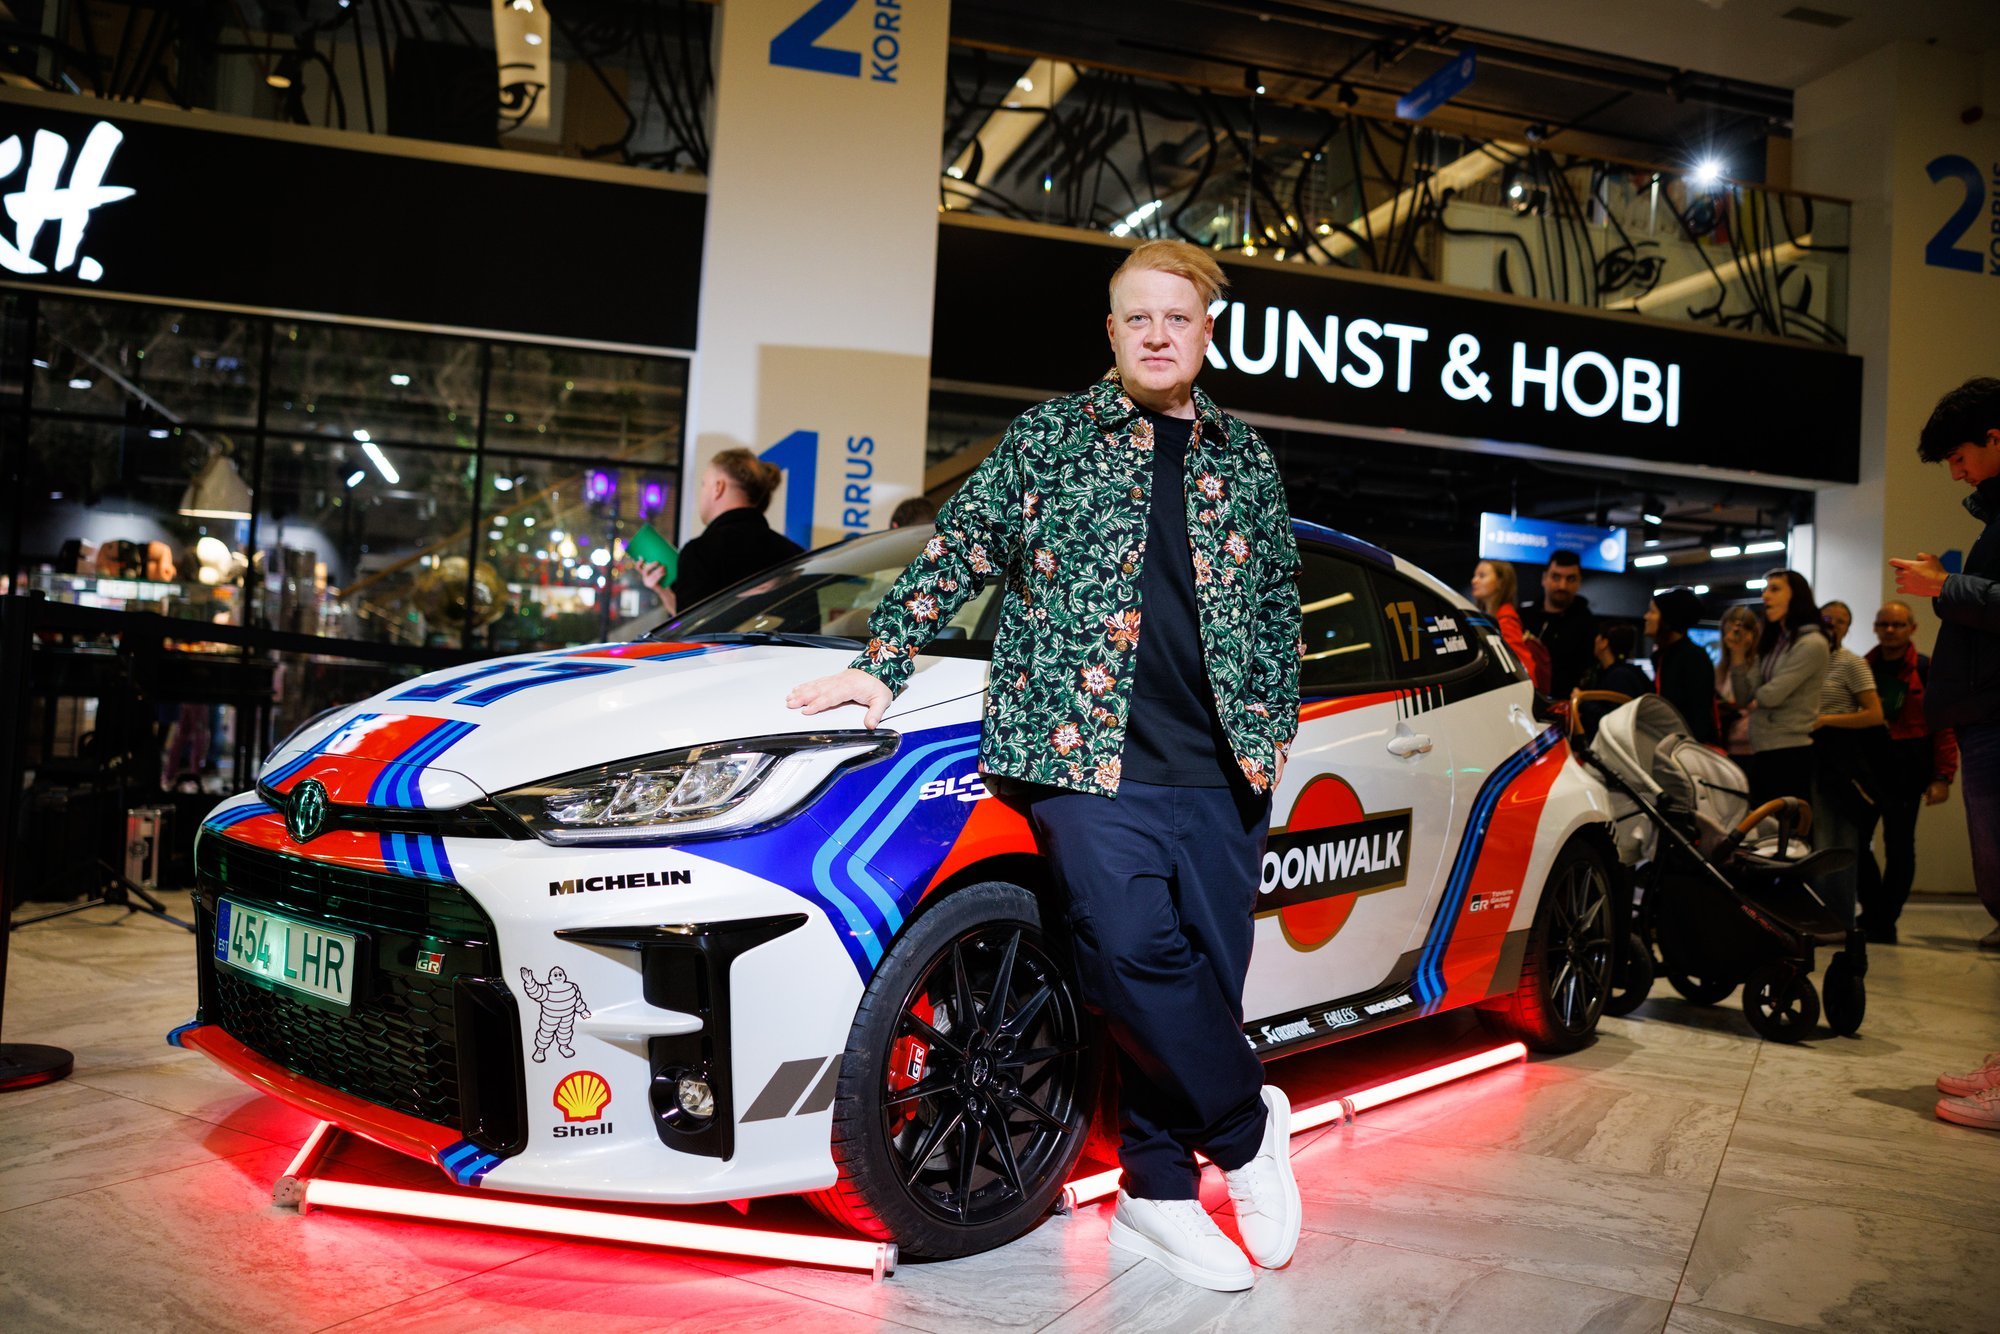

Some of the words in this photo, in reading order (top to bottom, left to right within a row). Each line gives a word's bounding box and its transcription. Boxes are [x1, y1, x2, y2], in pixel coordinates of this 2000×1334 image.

[769, 0, 862, 78] 2
[1925, 154, 1985, 275] 2
[1441, 333, 1493, 403] &
[1511, 341, 1681, 427] HOBI
[758, 429, 819, 552] 1
[843, 436, 875, 541] RRUS
[1385, 601, 1420, 662] 17
[387, 661, 636, 708] 17
[549, 870, 691, 897] MICHELIN
[1259, 829, 1404, 894] OONWALK
[1470, 900, 1489, 912] GR
[218, 938, 229, 952] EST
[232, 911, 271, 969] 454
[284, 927, 345, 993] LHR
[417, 959, 440, 973] GR
[1324, 1006, 1359, 1028] ENDLESS
[912, 1047, 924, 1078] GR
[553, 1122, 613, 1138] Shell
